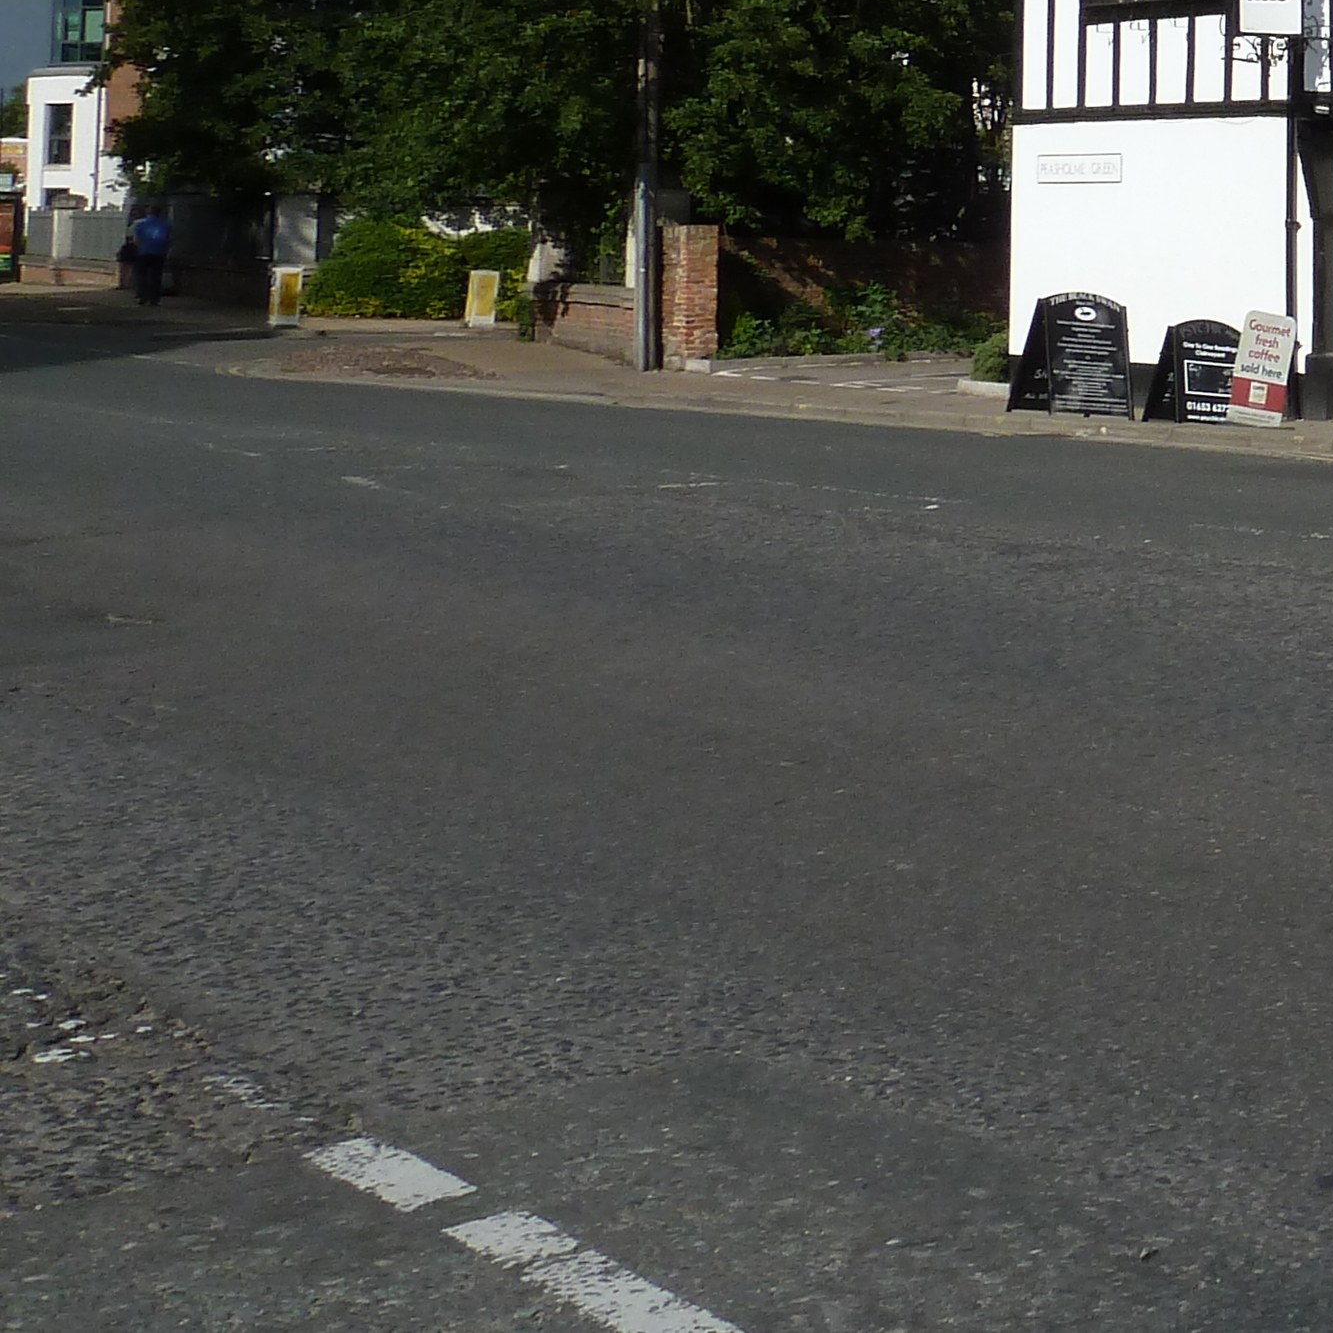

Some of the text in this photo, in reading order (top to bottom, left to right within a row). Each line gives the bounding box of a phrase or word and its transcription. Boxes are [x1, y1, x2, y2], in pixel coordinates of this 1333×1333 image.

[1250, 319, 1292, 337] Gourmet
[1255, 335, 1279, 349] fresh
[1248, 348, 1281, 363] coffee
[1241, 362, 1283, 379] sold here
